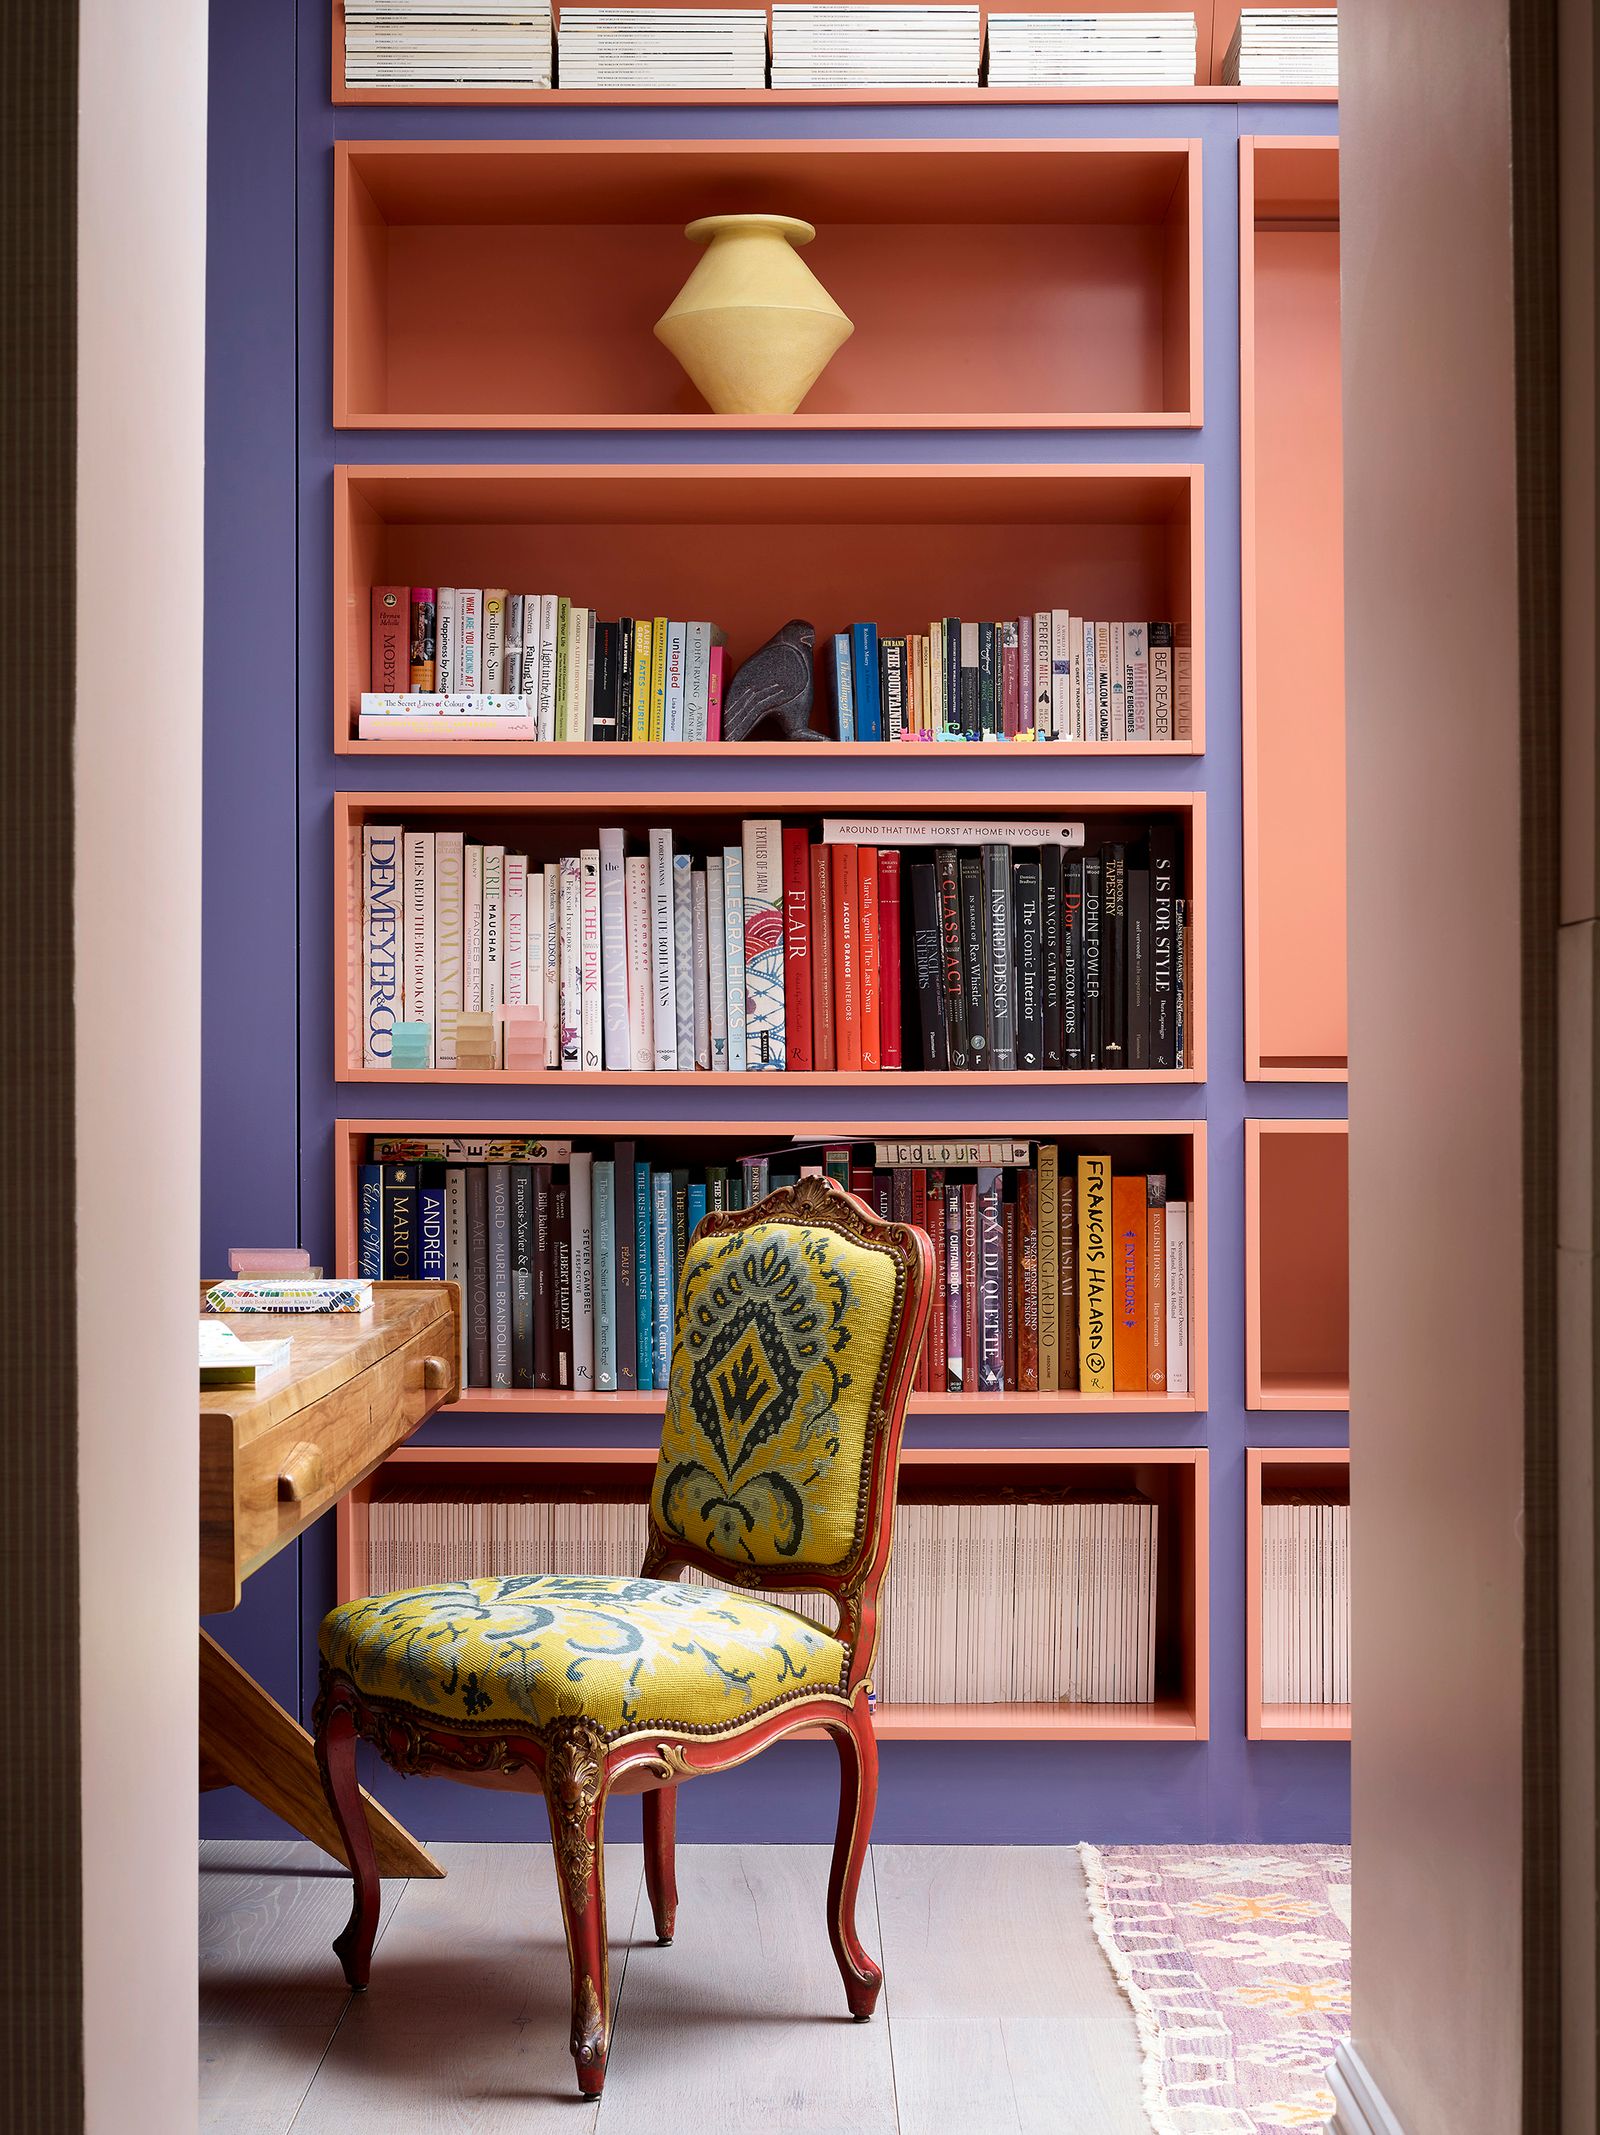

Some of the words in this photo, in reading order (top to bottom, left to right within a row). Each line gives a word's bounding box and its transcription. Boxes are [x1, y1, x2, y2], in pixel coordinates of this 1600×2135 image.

[466, 597, 474, 615] WHAT
[466, 617, 474, 629] ARE
[487, 601, 500, 640] Circling
[441, 617, 450, 659] Happiness
[466, 632, 474, 644] YOU
[489, 643, 498, 656] the
[693, 638, 702, 662] JOHN
[1039, 622, 1048, 662] PERFECT
[384, 634, 396, 694] MOBY-D
[440, 660, 450, 670] by
[465, 646, 474, 674] LOOKING
[487, 659, 498, 680] Sun
[523, 646, 535, 680] Falling
[541, 648, 552, 668] Light
[543, 670, 551, 678] in
[670, 638, 680, 688] untangled
[888, 647, 900, 668] THE
[1155, 652, 1166, 681] BEAT
[439, 672, 450, 694] Desig
[465, 676, 474, 688] AT?
[523, 681, 534, 695] Up
[542, 679, 551, 692] the
[1039, 664, 1048, 686] MILE
[540, 693, 551, 712] Attic
[1134, 662, 1147, 730] Middlesex
[1156, 684, 1167, 734] READER
[756, 826, 768, 860] TEXTILES
[840, 826, 880, 834] AROUND
[882, 826, 902, 834] THAT
[905, 826, 926, 834] TIME
[931, 827, 960, 835] HORST
[975, 828, 1002, 836] HOME
[1005, 828, 1016, 836] IN
[1018, 828, 1050, 836] VOGUE
[414, 840, 424, 876] MILES
[756, 861, 767, 870] OF
[1155, 859, 1170, 870] S
[414, 879, 424, 912] REDD
[585, 880, 596, 898] IN
[757, 872, 768, 894] JAPAN
[864, 877, 872, 910] Marella
[1106, 860, 1116, 917] TAPESTRY
[1155, 876, 1170, 892] IS
[585, 906, 596, 940] THE
[726, 856, 743, 958] ALLEGRA
[943, 880, 959, 944] CLASS
[992, 889, 1006, 958] INSPIRED
[1024, 900, 1036, 926] The
[1046, 886, 1056, 947] FRANÇOIS
[1064, 892, 1082, 930] Dior
[1087, 892, 1099, 932] JOHN
[1116, 905, 1124, 917] OF
[1155, 898, 1170, 931] FOR
[414, 914, 424, 940] THE
[789, 890, 807, 960] FLAIR
[862, 912, 872, 942] Agnelli
[970, 932, 976, 942] OF
[414, 942, 424, 964] BIG
[864, 948, 873, 966] The
[970, 944, 980, 962] Rex
[1024, 929, 1036, 968] Iconic
[1155, 936, 1170, 992] STYLE
[414, 965, 424, 998] BOOK
[585, 951, 596, 992] PINK
[864, 968, 874, 988] Last
[947, 956, 961, 995] ACT
[970, 964, 981, 1006] Whistler
[1048, 952, 1056, 1008] CATROUX
[1087, 939, 1100, 998] FOWLER
[728, 964, 744, 1028] HICKS
[865, 990, 874, 1013] Swan
[993, 963, 1008, 1018] DESIGN
[1024, 972, 1036, 1021] Interior
[1066, 959, 1075, 1034] DECORATORS
[414, 1000, 424, 1016] OF
[900, 1146, 978, 1160] COLOUR
[362, 1183, 381, 1216] Elsie
[1041, 1158, 1054, 1214] RENZO
[655, 1190, 668, 1225] English
[880, 1190, 888, 1220] ALIDA
[950, 1196, 958, 1212] THE
[980, 1192, 998, 1244] TONY
[1061, 1189, 1072, 1232] NICKY
[1086, 1160, 1105, 1262] FRANÇOIS
[363, 1218, 378, 1233] de
[393, 1196, 410, 1266] MARIO
[424, 1196, 442, 1268] ANDRÉE
[638, 1220, 646, 1264] COUNTRY
[359, 1234, 381, 1275] Wolfe
[560, 1241, 569, 1285] ALBERT
[582, 1228, 590, 1265] STEVEN
[657, 1226, 668, 1276] Decoration
[950, 1235, 959, 1270] CURTAIN
[658, 1277, 668, 1286] in
[1062, 1236, 1072, 1296] HASLAM
[1125, 1242, 1136, 1315] INTERIORS
[583, 1270, 592, 1314] GAMBREL
[639, 1268, 647, 1300] HOUSE
[658, 1288, 668, 1302] the
[951, 1272, 959, 1296] BOOK
[1042, 1220, 1055, 1347] MONGIARDINO
[560, 1288, 570, 1330] HADLEY
[658, 1304, 668, 1322] 18th
[980, 1252, 1000, 1361] DUQUETTE
[1086, 1268, 1105, 1350] HALARD
[656, 1324, 668, 1362] Century
